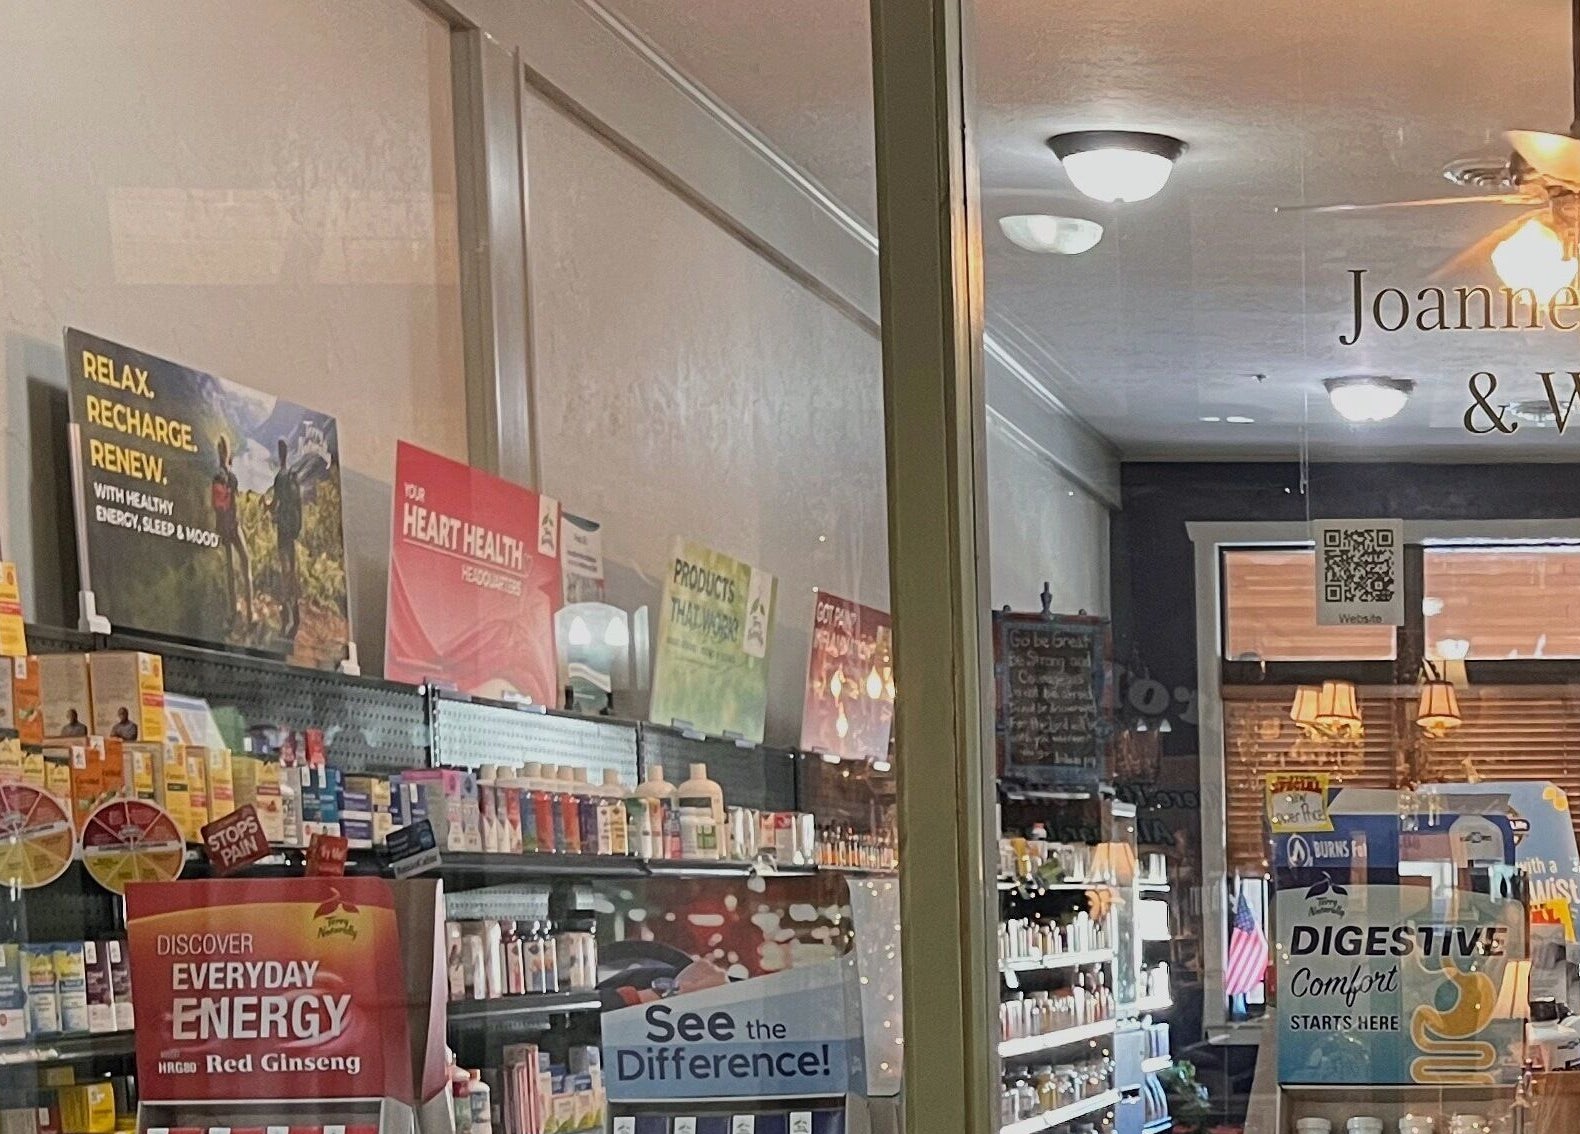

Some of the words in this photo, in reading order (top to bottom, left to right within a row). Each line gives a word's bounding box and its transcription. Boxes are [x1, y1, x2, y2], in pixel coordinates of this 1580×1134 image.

[83, 350, 154, 399] RELAX.
[1463, 371, 1518, 434] &
[86, 395, 198, 453] RECHARGE.
[90, 439, 168, 485] RENEW.
[94, 482, 124, 504] WITH
[126, 491, 173, 516] HEALTHY
[404, 483, 425, 502] YOUR
[96, 505, 141, 532] ENERGY,
[142, 516, 174, 537] SLEEP
[177, 523, 184, 540] &
[186, 527, 219, 548] MOOD
[403, 502, 461, 550] HEART
[463, 522, 523, 570] HEALTH
[674, 558, 735, 604] PRODUCTS
[1339, 612, 1383, 625] Website
[208, 815, 259, 852] STOPS
[220, 837, 259, 867] PAIN
[157, 934, 253, 955] DISCOVER
[1290, 926, 1507, 956] DIGESTIVE
[173, 960, 319, 990] EVERYDAY
[1291, 965, 1398, 1007] Comfort
[173, 994, 351, 1040] ENERGY
[646, 1004, 736, 1042] See
[746, 1020, 786, 1040] the
[1291, 1015, 1352, 1030] STARTS
[1359, 1015, 1399, 1030] HERE
[206, 1054, 253, 1073] Red
[261, 1052, 361, 1075] Ginseng
[617, 1044, 830, 1081] Difference!
